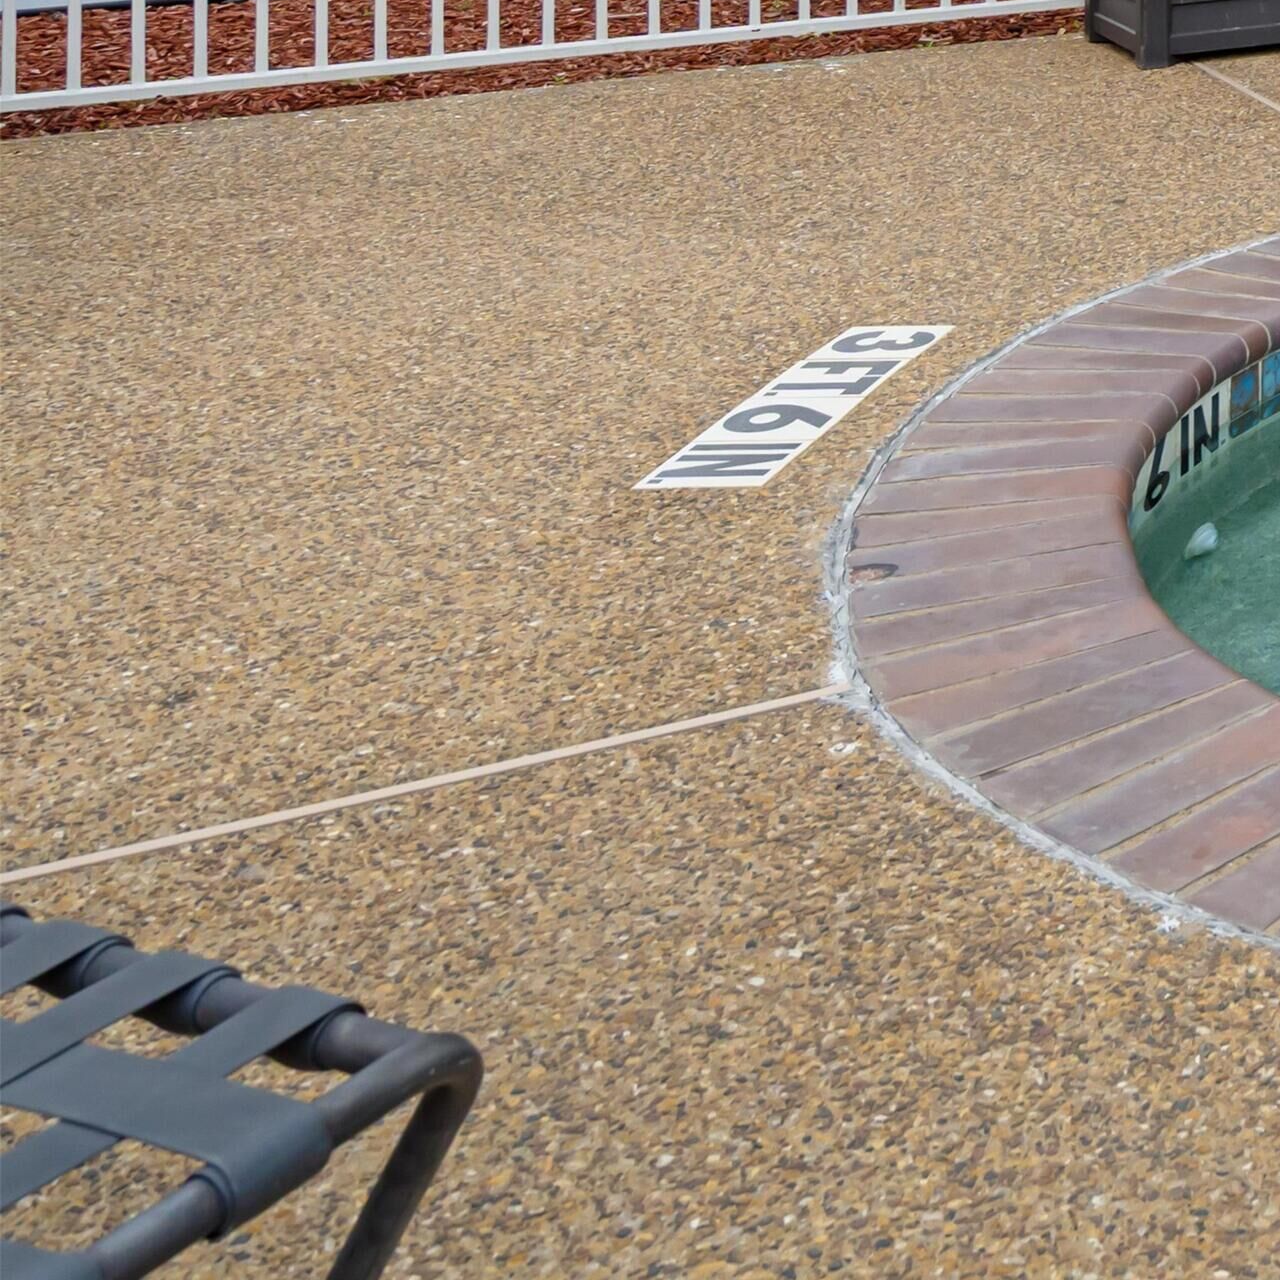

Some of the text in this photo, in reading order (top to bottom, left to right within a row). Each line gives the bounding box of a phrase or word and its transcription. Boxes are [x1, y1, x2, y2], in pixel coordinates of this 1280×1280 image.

[646, 330, 936, 485] 3 FT. 6 IN.
